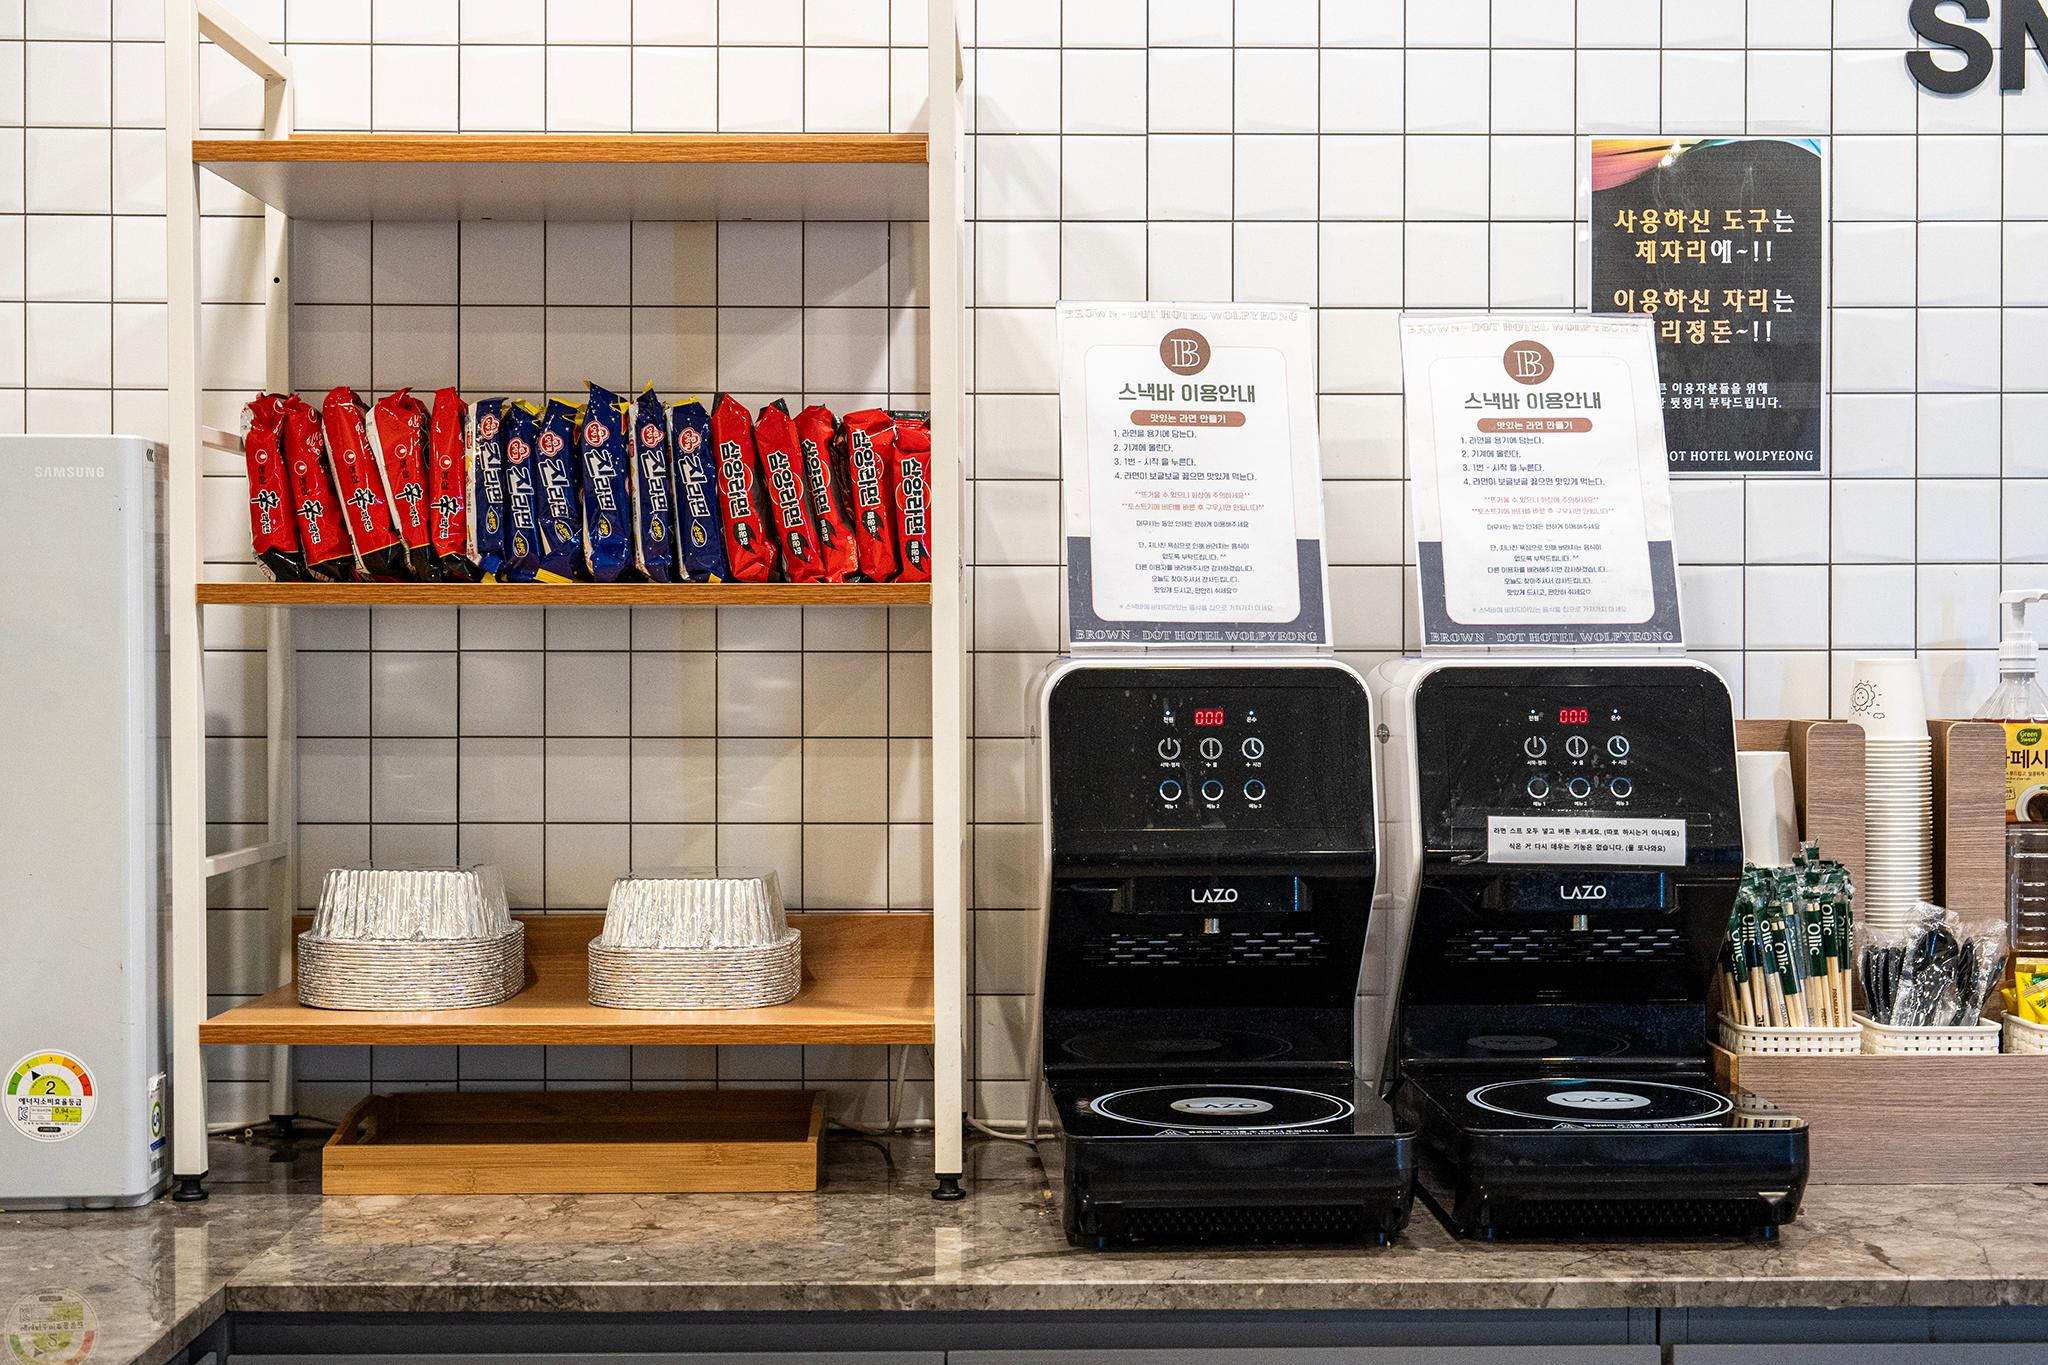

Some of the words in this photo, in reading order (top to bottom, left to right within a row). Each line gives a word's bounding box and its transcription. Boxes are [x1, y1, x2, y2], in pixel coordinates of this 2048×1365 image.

[1613, 209, 1710, 233] 사용하신
[1722, 209, 1795, 233] 도구는
[1636, 240, 1771, 264] 제자리에~!!
[1614, 289, 1710, 313] 이용하신
[1722, 289, 1795, 313] 자리는
[1654, 321, 1771, 344] 리정돈~!!
[1118, 383, 1175, 402] 스낵바
[1181, 384, 1256, 403] 이용안내
[1672, 383, 1742, 395] 이용자분들을
[1746, 383, 1768, 395] 위해
[1464, 393, 1520, 410] 스낵바
[1527, 392, 1601, 410] 이용안내
[1671, 397, 1704, 409] 뒷정리
[1709, 397, 1782, 409] 부탁드립니다.
[1150, 414, 1176, 422] 맛있는
[1180, 414, 1196, 423] 라면
[1200, 414, 1226, 423] 만들기
[1497, 421, 1523, 430] 맛있는
[1526, 422, 1544, 430] 라면
[1547, 422, 1573, 430] 만들기
[1122, 429, 1144, 438] 라면을
[1147, 430, 1170, 438] 용기에
[1172, 430, 1196, 438] 담는다.
[1114, 444, 1120, 452] 2.
[1124, 444, 1146, 452] 기계에
[1148, 444, 1173, 452] 올린다.
[1462, 450, 1469, 458] 2.
[1472, 450, 1494, 458] 기계에
[1114, 458, 1121, 466] 3.
[1124, 458, 1135, 466] 1번
[1144, 458, 1159, 466] 시작
[1172, 458, 1196, 466] 누른다.
[1667, 451, 1686, 461] OT
[1691, 451, 1731, 461] HOTEL
[1735, 450, 1813, 462] WOLPYEONG
[34, 466, 105, 479] SAMSUNG
[480, 442, 503, 503] 진라면
[852, 430, 881, 508] 삼양라면
[1115, 472, 1122, 480] 4.
[1124, 472, 1147, 480] 라면이
[1150, 472, 1179, 480] 보글보글
[1182, 472, 1204, 480] 끓으면
[1207, 472, 1230, 481] 맛있게
[1232, 473, 1257, 481] 먹는다.
[584, 449, 616, 510] 진라면
[640, 450, 668, 512] 진라면
[720, 440, 751, 518] 삼양라면
[801, 438, 830, 516] 삼양라면
[1498, 478, 1528, 486] 보글보글
[1530, 478, 1553, 486] 끓으면
[1555, 478, 1578, 486] 맛있게
[1580, 478, 1605, 486] 먹는다.
[538, 458, 570, 518] 진라면
[678, 456, 710, 517] 진라면
[767, 450, 804, 528] 삼양라면
[506, 466, 535, 528] 진라면
[902, 458, 926, 536] 삼양라면
[1075, 629, 1131, 640] BROWN
[1142, 630, 1172, 641] DOT
[1174, 630, 1224, 641] HOTEL
[1226, 630, 1318, 642] WOLPYEONG
[1430, 632, 1484, 643] BROWN
[1496, 632, 1526, 643] DOT
[1529, 632, 1578, 643] HOTEL
[1580, 631, 1674, 642] WOLPYEONG
[1195, 711, 1224, 725] 000
[1559, 709, 1588, 724] 000
[2019, 729, 2038, 738] Green
[1493, 827, 1506, 835] 라면
[1574, 828, 1603, 836] 누르세요.
[1604, 828, 1619, 836] (따로
[1573, 843, 1593, 851] 기능은
[1596, 843, 1623, 851] 없습니다.
[1191, 888, 1238, 903] LAZO
[1560, 885, 1607, 900] LAZO
[1822, 903, 1833, 936] Ollic
[1760, 920, 1773, 953] Ollic
[1808, 922, 1822, 956] Ollic
[1775, 940, 1789, 974] Ollic
[45, 1080, 56, 1095] 2
[18, 1097, 82, 1106] 에너지소비효율등급
